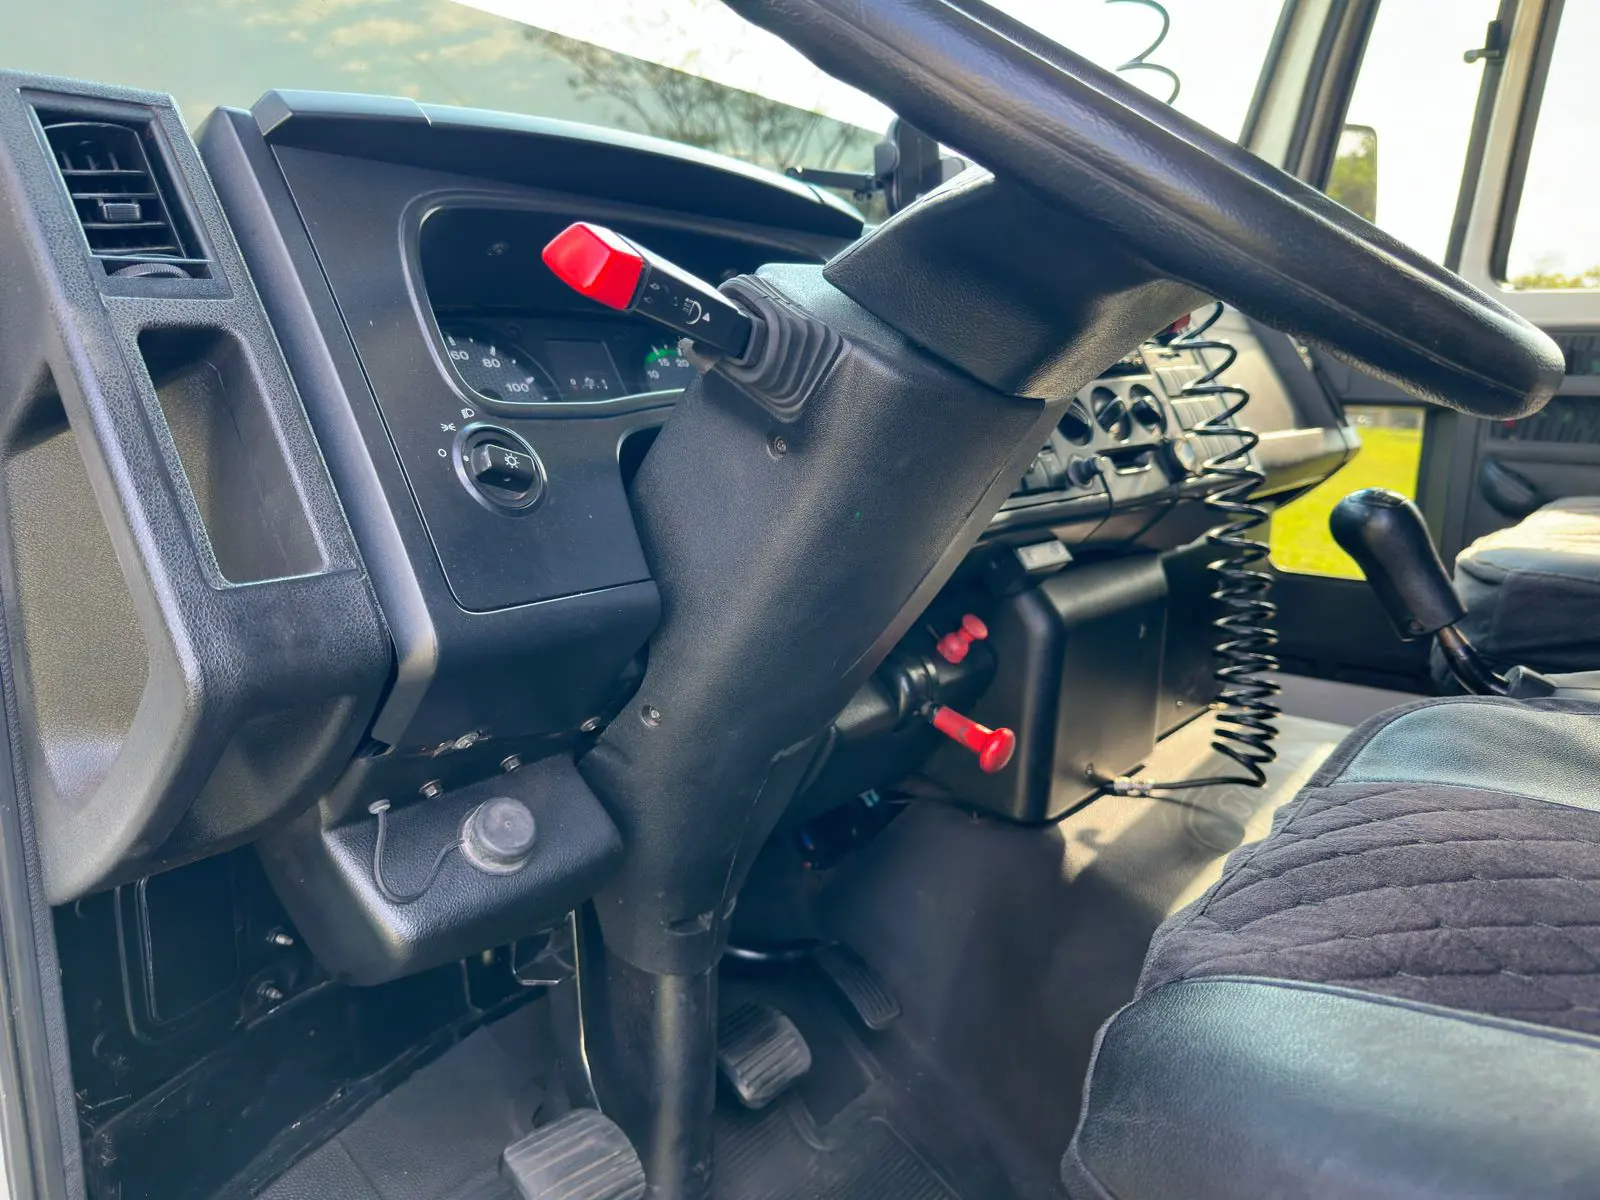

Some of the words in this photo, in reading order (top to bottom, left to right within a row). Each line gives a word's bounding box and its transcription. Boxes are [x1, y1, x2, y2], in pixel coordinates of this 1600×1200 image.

[450, 351, 469, 360] 60
[482, 358, 501, 368] 80
[657, 358, 670, 367] 15
[675, 358, 690, 368] 20
[647, 370, 660, 379] 10
[506, 383, 529, 392] 100
